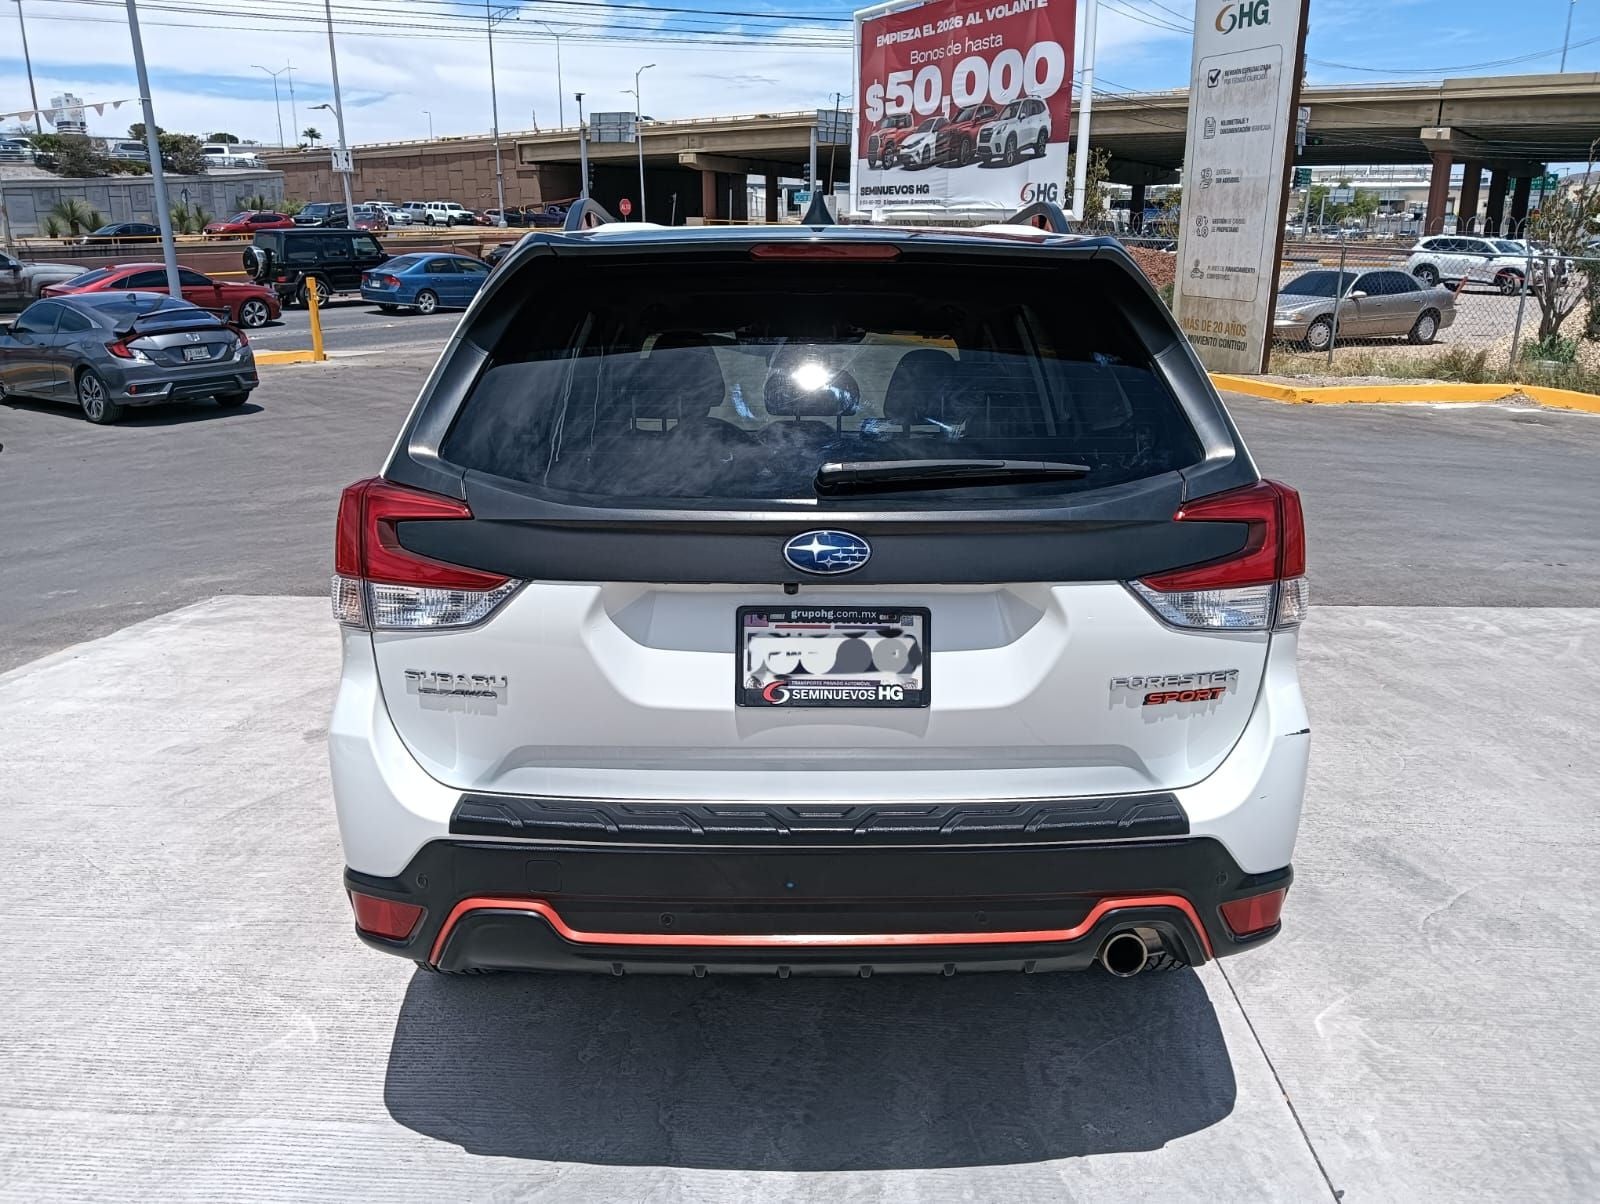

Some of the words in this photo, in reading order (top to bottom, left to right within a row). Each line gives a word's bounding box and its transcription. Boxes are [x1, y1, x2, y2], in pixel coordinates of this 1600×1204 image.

[876, 28, 922, 47] EMPIEZA
[923, 24, 936, 37] EL
[936, 15, 964, 34] 2026
[965, 11, 983, 26] AL
[986, 0, 1049, 21] VOLANTE
[1238, 0, 1270, 29] HG
[910, 49, 945, 65] Bonos
[946, 41, 962, 57] de
[965, 33, 1003, 54] hasta
[865, 40, 1066, 127] $50,000
[860, 185, 915, 196] SEMINUEVOS
[916, 184, 930, 194] HG
[1036, 182, 1058, 202] HG
[1201, 319, 1212, 332] DE
[1213, 320, 1223, 333] 20
[1225, 320, 1247, 337] AÑOS
[791, 609, 877, 620] grupohg.com.mx
[1109, 669, 1239, 690] FORESTER
[792, 689, 876, 700] SEMINUEVOS
[878, 686, 904, 701] HG
[1144, 687, 1226, 705] SPORT
